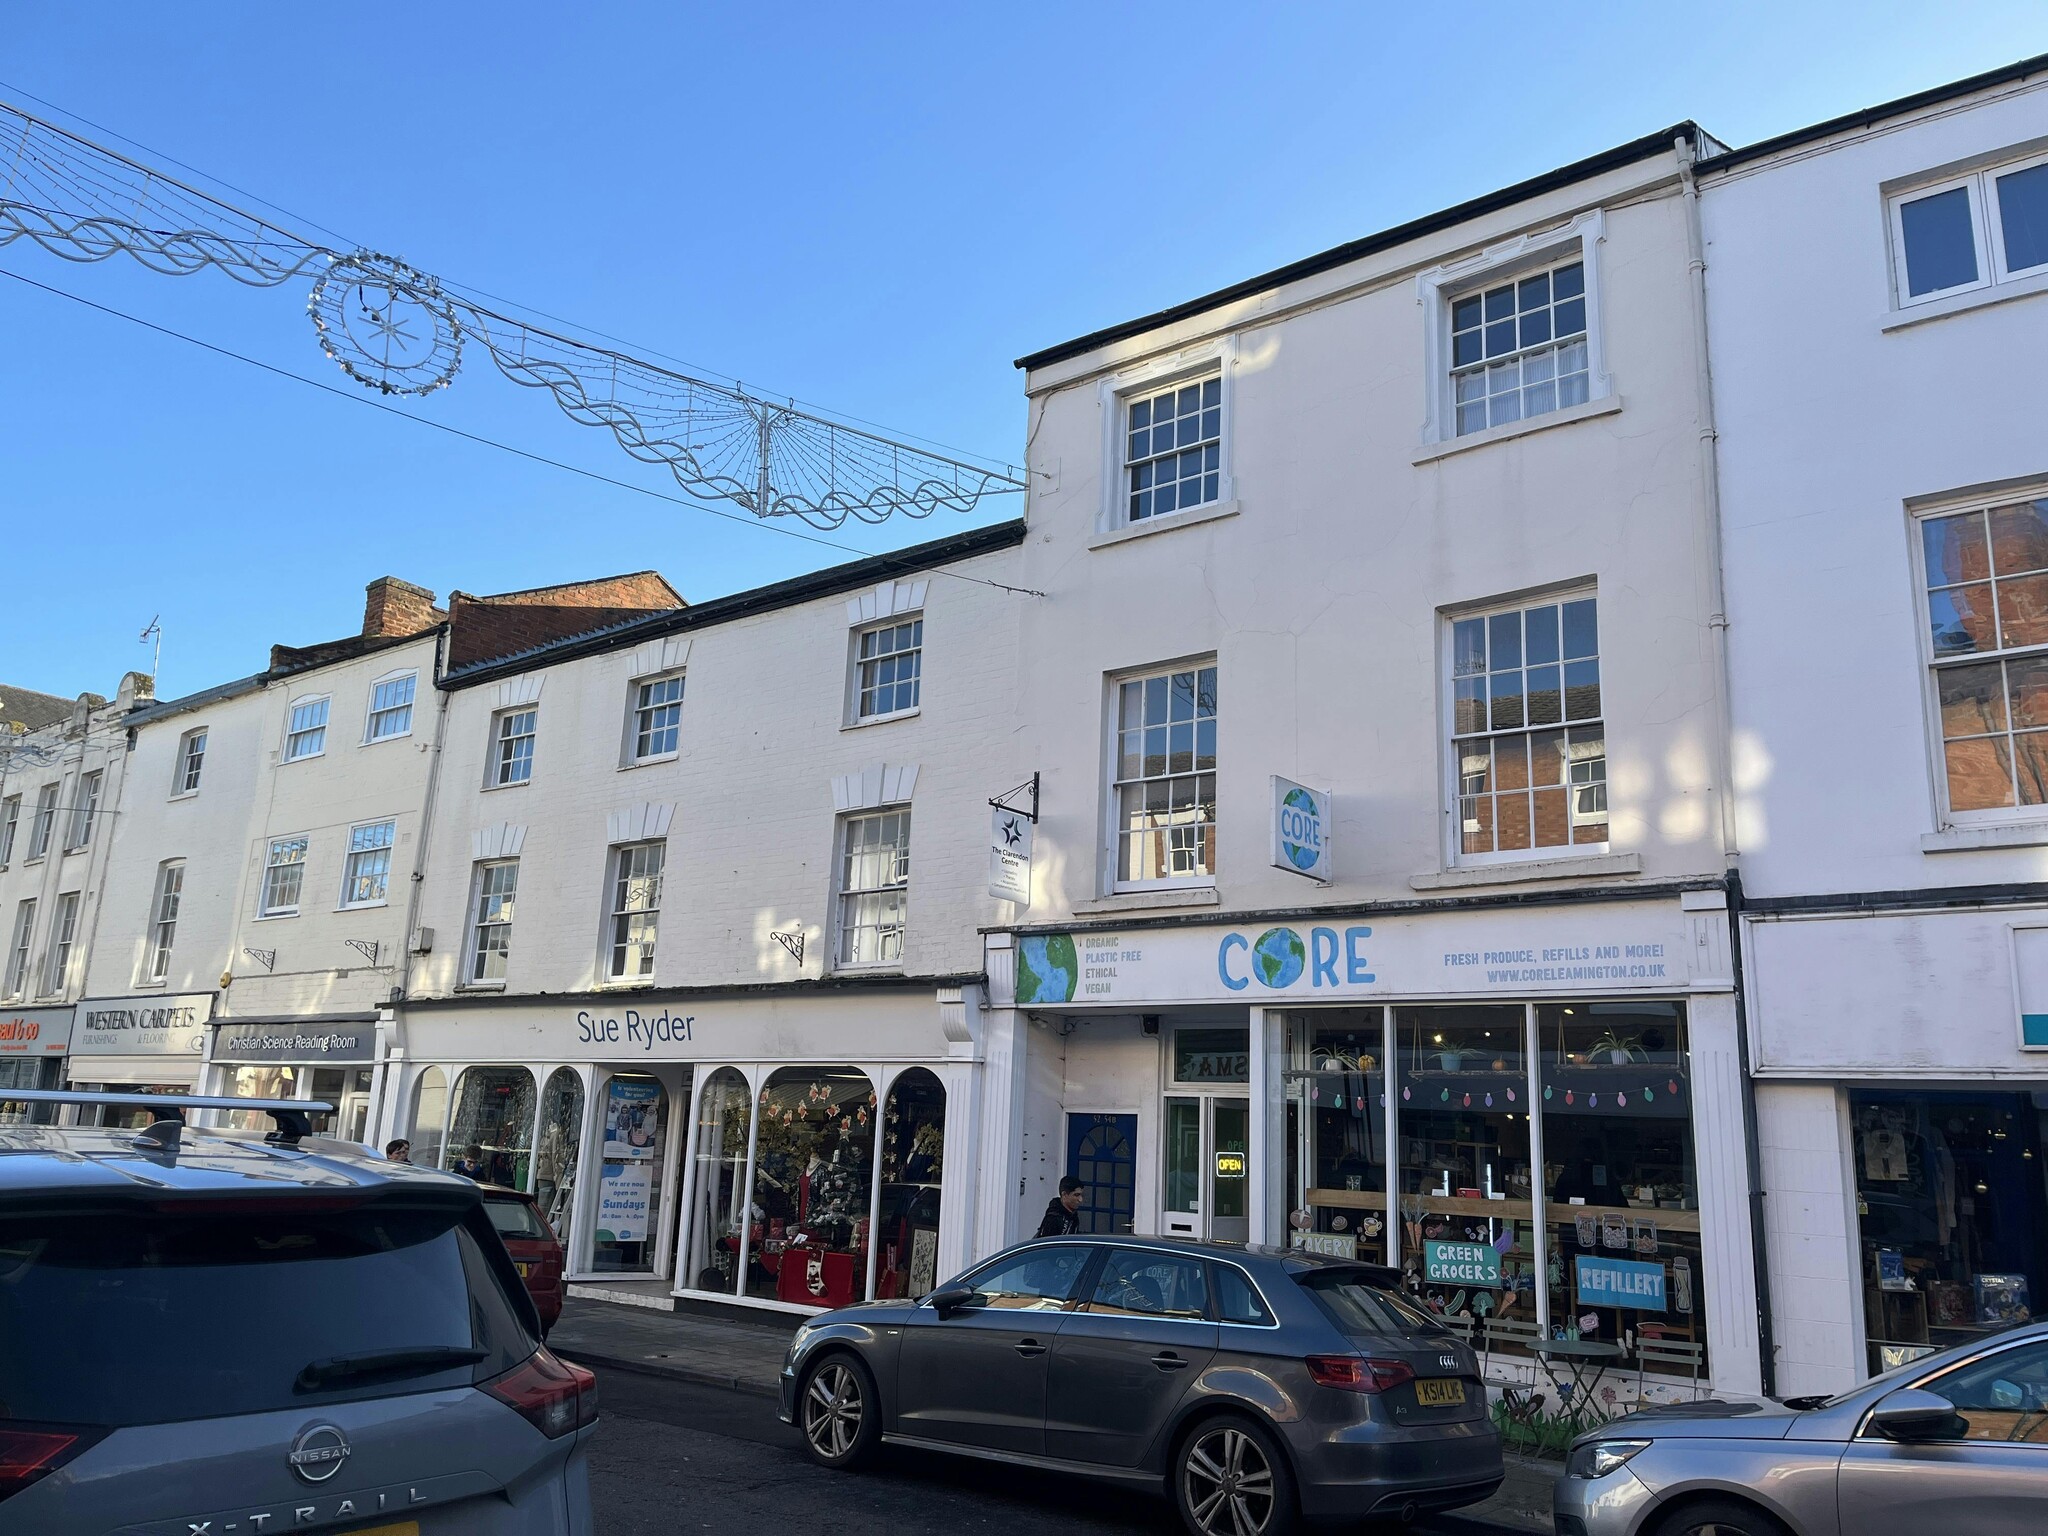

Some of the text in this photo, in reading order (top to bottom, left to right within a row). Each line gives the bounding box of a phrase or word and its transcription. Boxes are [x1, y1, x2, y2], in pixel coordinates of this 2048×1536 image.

[1281, 808, 1321, 846] CORE
[992, 846, 1029, 861] The Clarendon
[1001, 857, 1019, 867] Centre
[1086, 937, 1119, 948] ORGANIC
[1086, 951, 1142, 963] PLASTIC FREE
[1218, 926, 1376, 991] CORE
[1444, 944, 1664, 966] FRESH PRODUCE, REFILLS AND MORE!
[1086, 967, 1118, 979] ETHICAL
[1487, 964, 1666, 983] WWW.CORELEAMINGTON.CO.UK
[1086, 983, 1111, 994] VEGAN
[86, 1007, 195, 1030] WESTERN CARPETS
[26, 1023, 40, 1040] co
[577, 1009, 695, 1050] Sue Ryder
[82, 1033, 176, 1045] FURNISHINGS & FLOORING
[228, 1034, 356, 1052] Christian Science Reading Room
[1219, 1159, 1242, 1170] OPEN
[603, 1199, 645, 1211] Sundays
[1436, 1245, 1484, 1262] GREEN
[1430, 1264, 1498, 1281] GROCERS
[1580, 1267, 1662, 1297] REFILLERY
[1422, 1382, 1446, 1401] KS14
[290, 1447, 352, 1464] NISSAN
[187, 1487, 428, 1536] X-TRAIL
